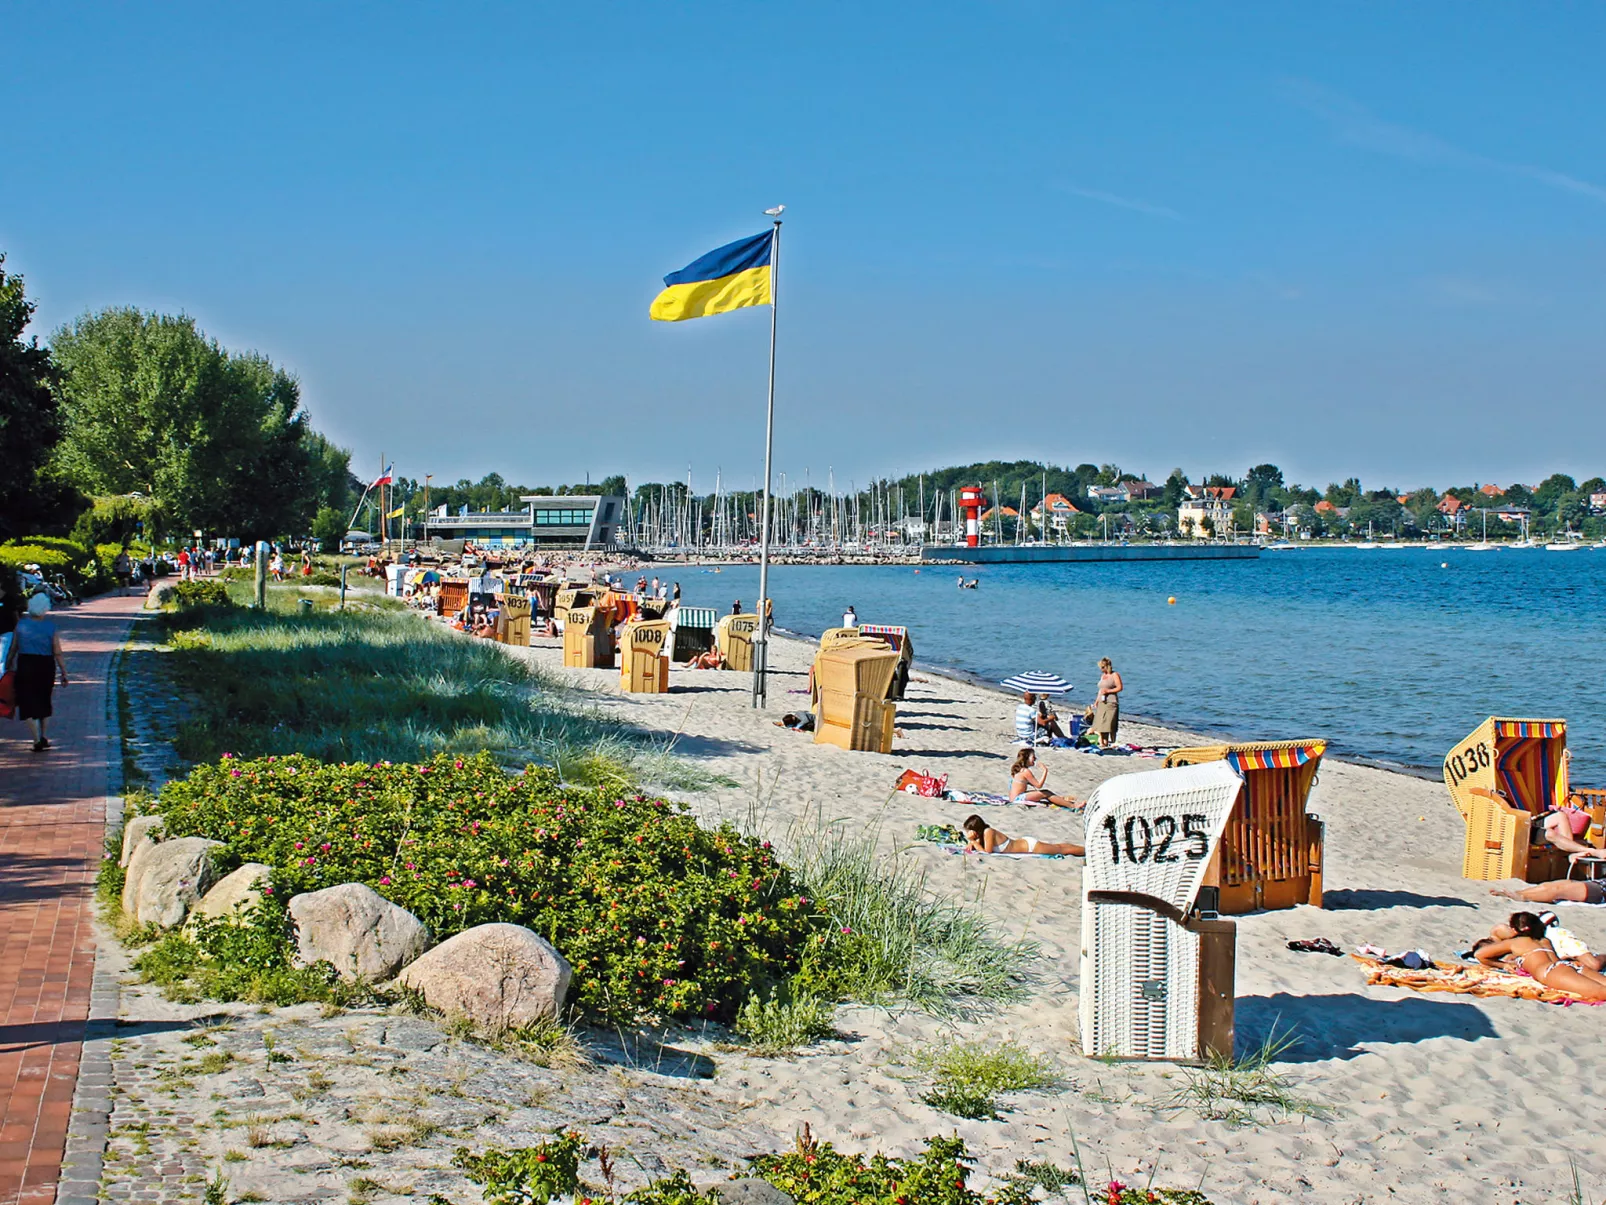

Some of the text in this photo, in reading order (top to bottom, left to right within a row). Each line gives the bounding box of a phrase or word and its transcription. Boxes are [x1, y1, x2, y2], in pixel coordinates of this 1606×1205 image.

[508, 597, 528, 609] 1037
[732, 619, 754, 632] 1075
[634, 629, 662, 643] 1008
[1445, 742, 1490, 787] 1038
[1102, 814, 1210, 864] 1025
